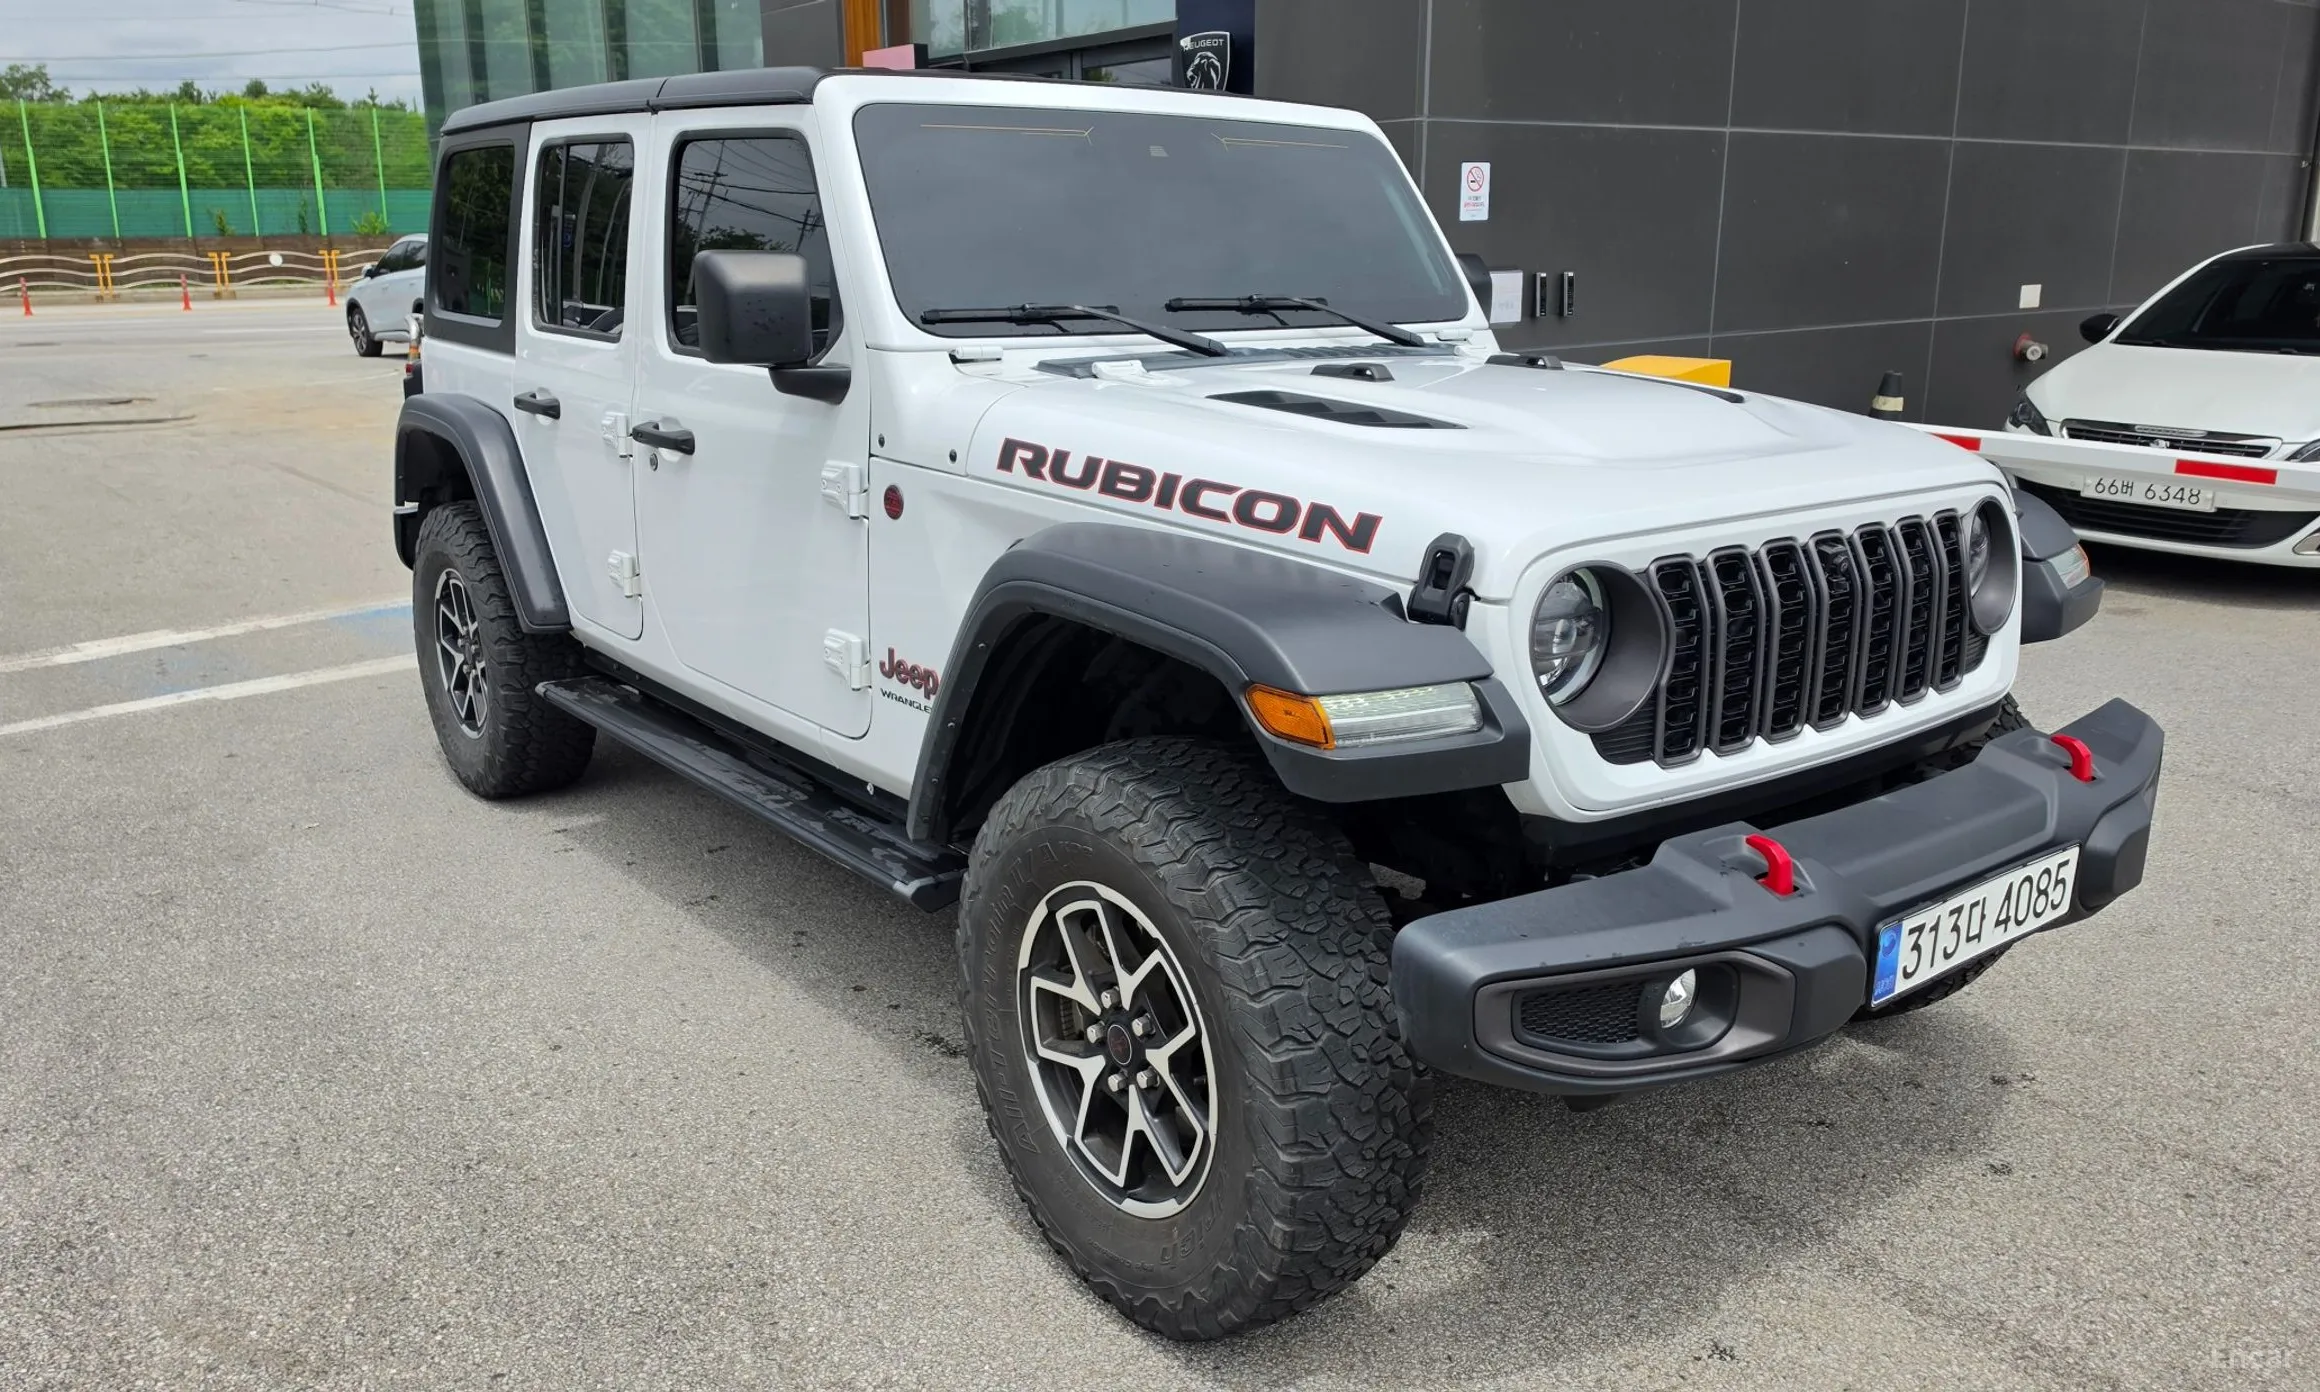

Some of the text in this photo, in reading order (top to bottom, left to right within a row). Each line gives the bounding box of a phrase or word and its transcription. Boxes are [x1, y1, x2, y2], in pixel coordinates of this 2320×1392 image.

[996, 437, 1383, 554] RUBICON
[2095, 478, 2201, 505] 66버 6348
[879, 647, 940, 700] Jeep
[880, 687, 934, 715] WRANGLE
[1902, 858, 2071, 980] 313다 4085
